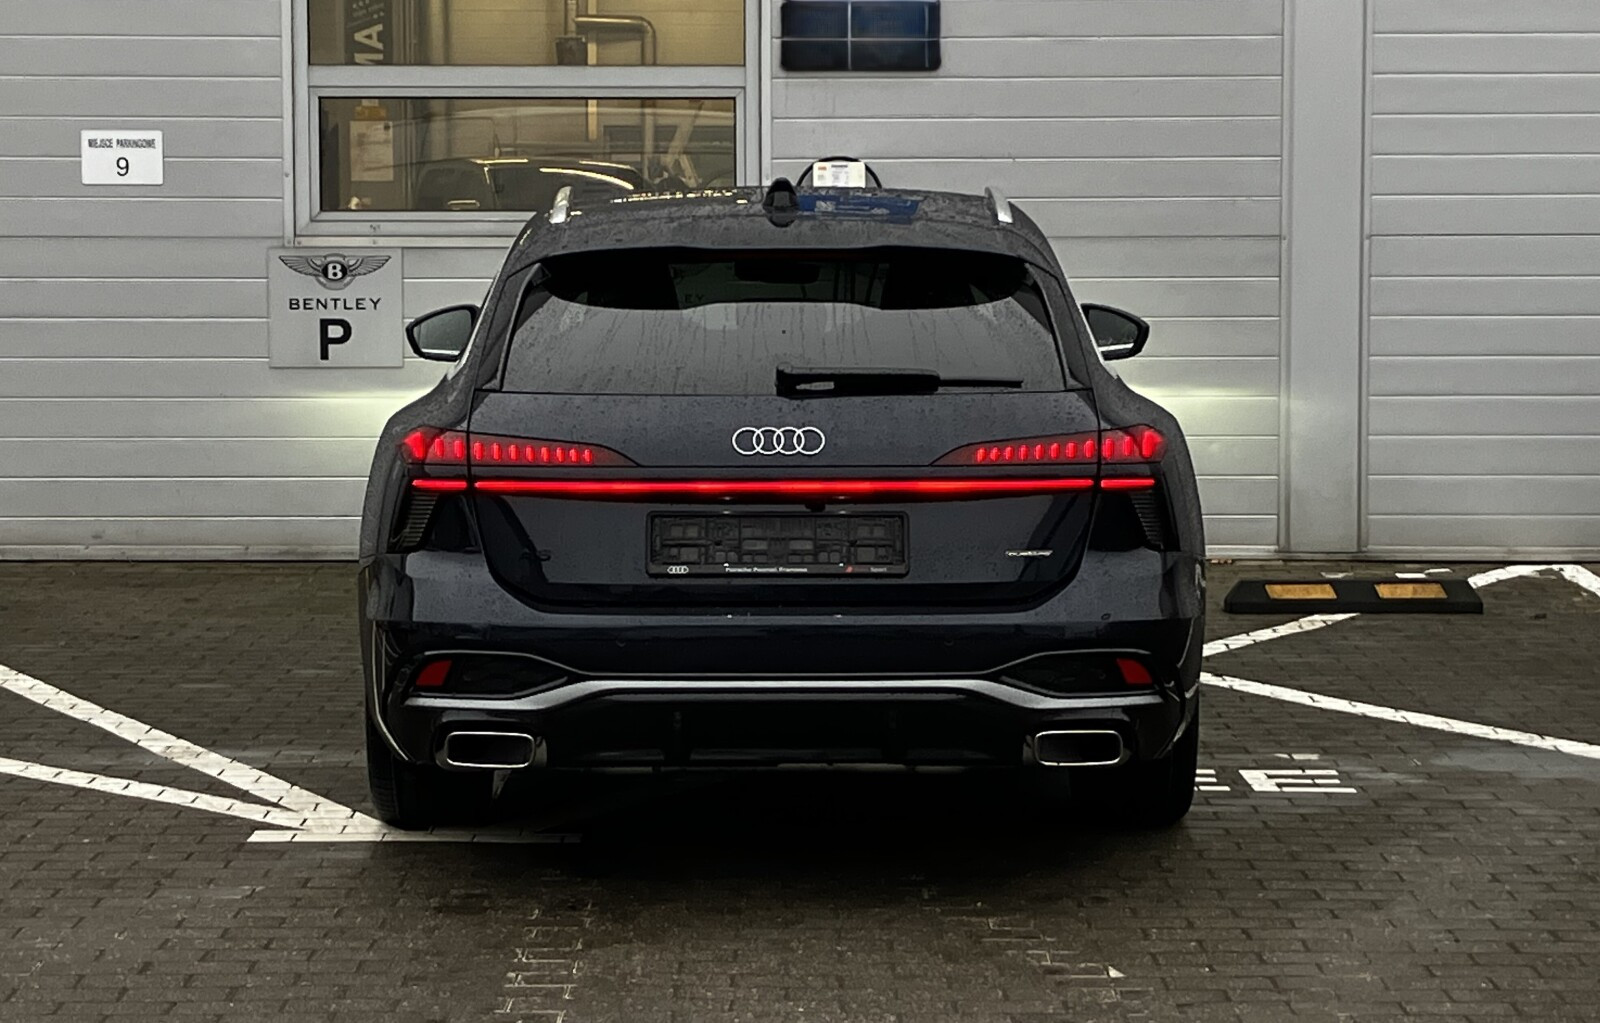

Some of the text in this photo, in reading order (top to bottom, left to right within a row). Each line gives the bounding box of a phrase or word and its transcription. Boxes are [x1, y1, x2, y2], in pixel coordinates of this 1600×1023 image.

[116, 156, 129, 177] 9
[327, 262, 343, 280] B
[288, 297, 381, 311] BENTLEY
[319, 318, 352, 361] P
